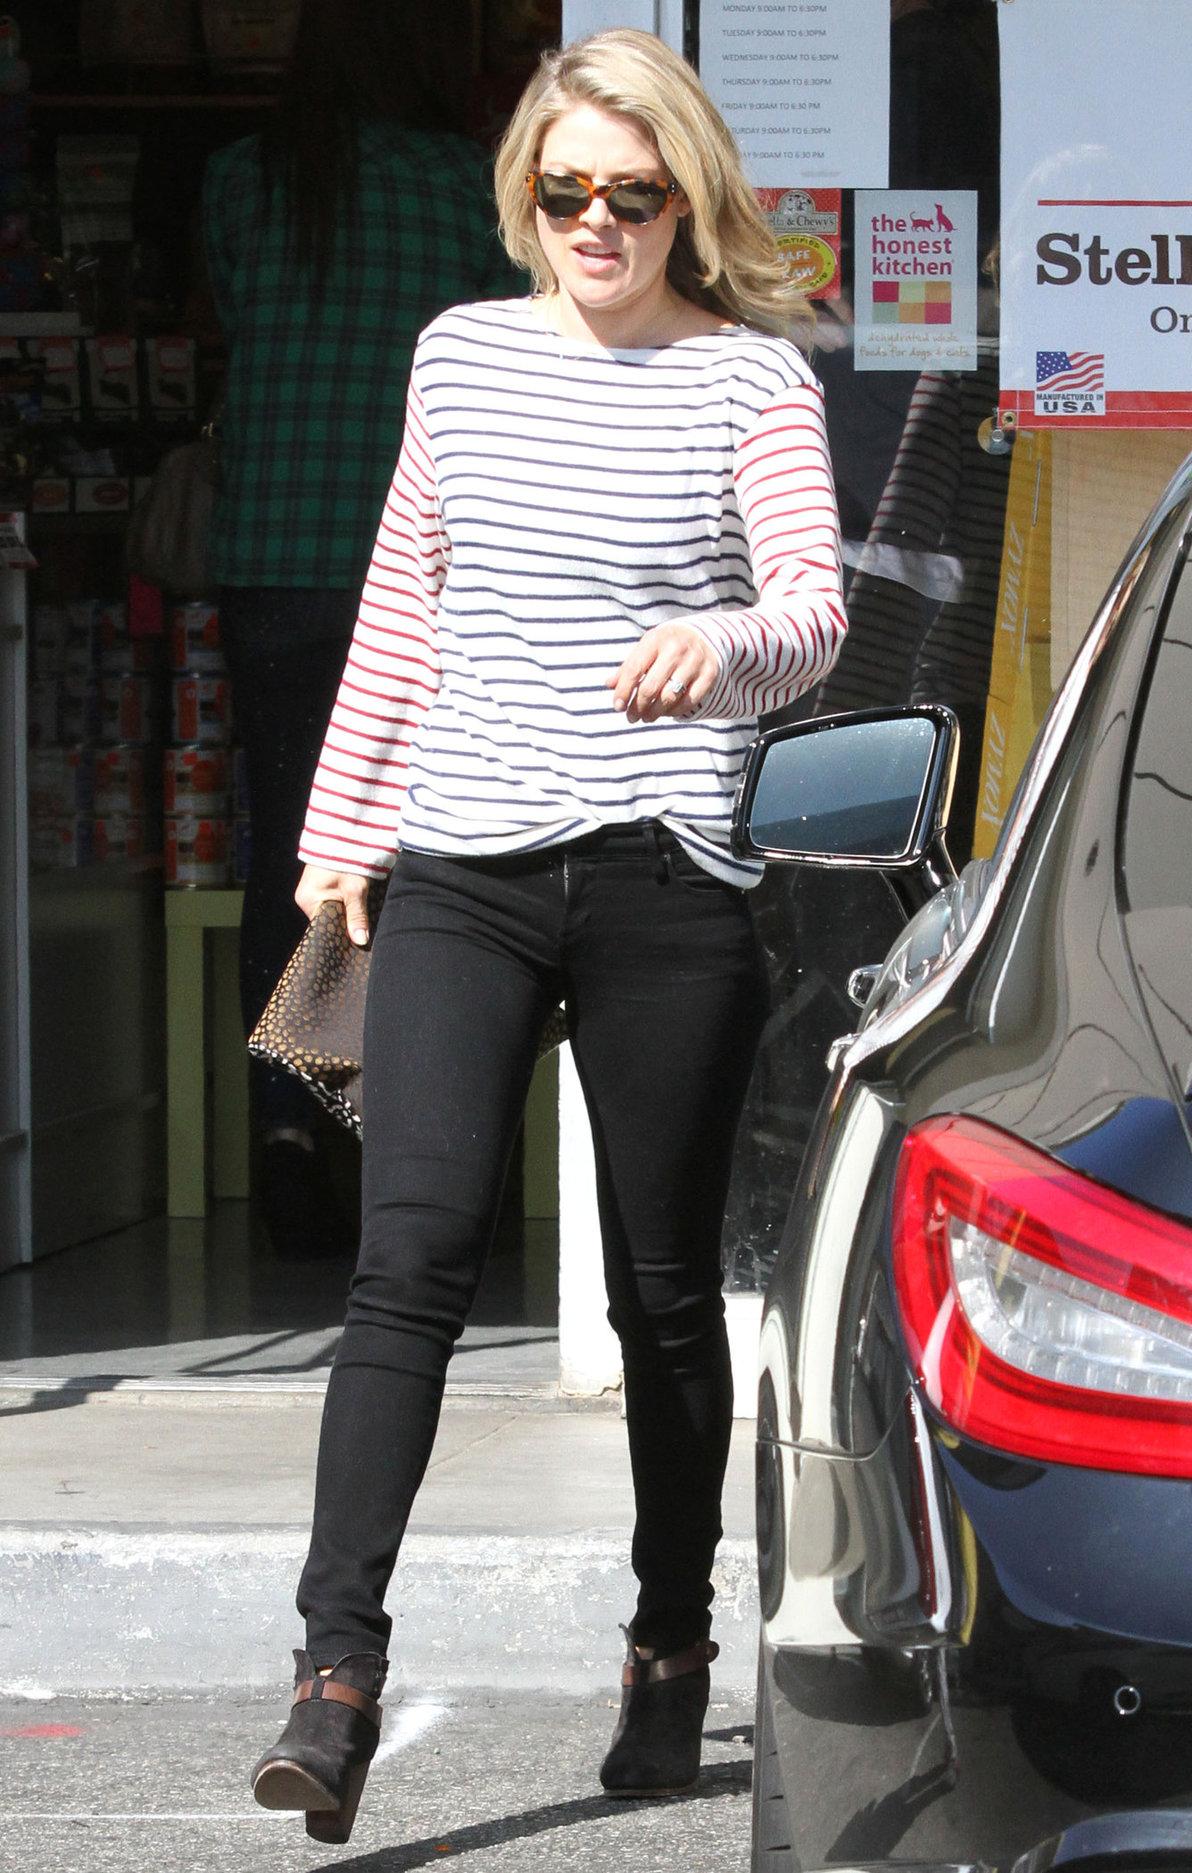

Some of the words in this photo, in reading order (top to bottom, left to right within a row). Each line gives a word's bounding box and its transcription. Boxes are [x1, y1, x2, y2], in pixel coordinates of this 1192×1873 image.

[722, 29, 754, 37] TUESDAY
[722, 78, 761, 86] THURSDAY
[731, 127, 760, 135] TURDAY
[792, 127, 802, 135] TO
[786, 217, 795, 226] &
[796, 214, 835, 230] Chewy's
[871, 213, 907, 232] the
[871, 235, 952, 254] honest
[777, 250, 811, 262] SAFE
[1036, 232, 1192, 285] Stell
[871, 257, 953, 275] kitchen
[1036, 393, 1094, 401] MANUFACTURED
[1043, 401, 1097, 413] USA
